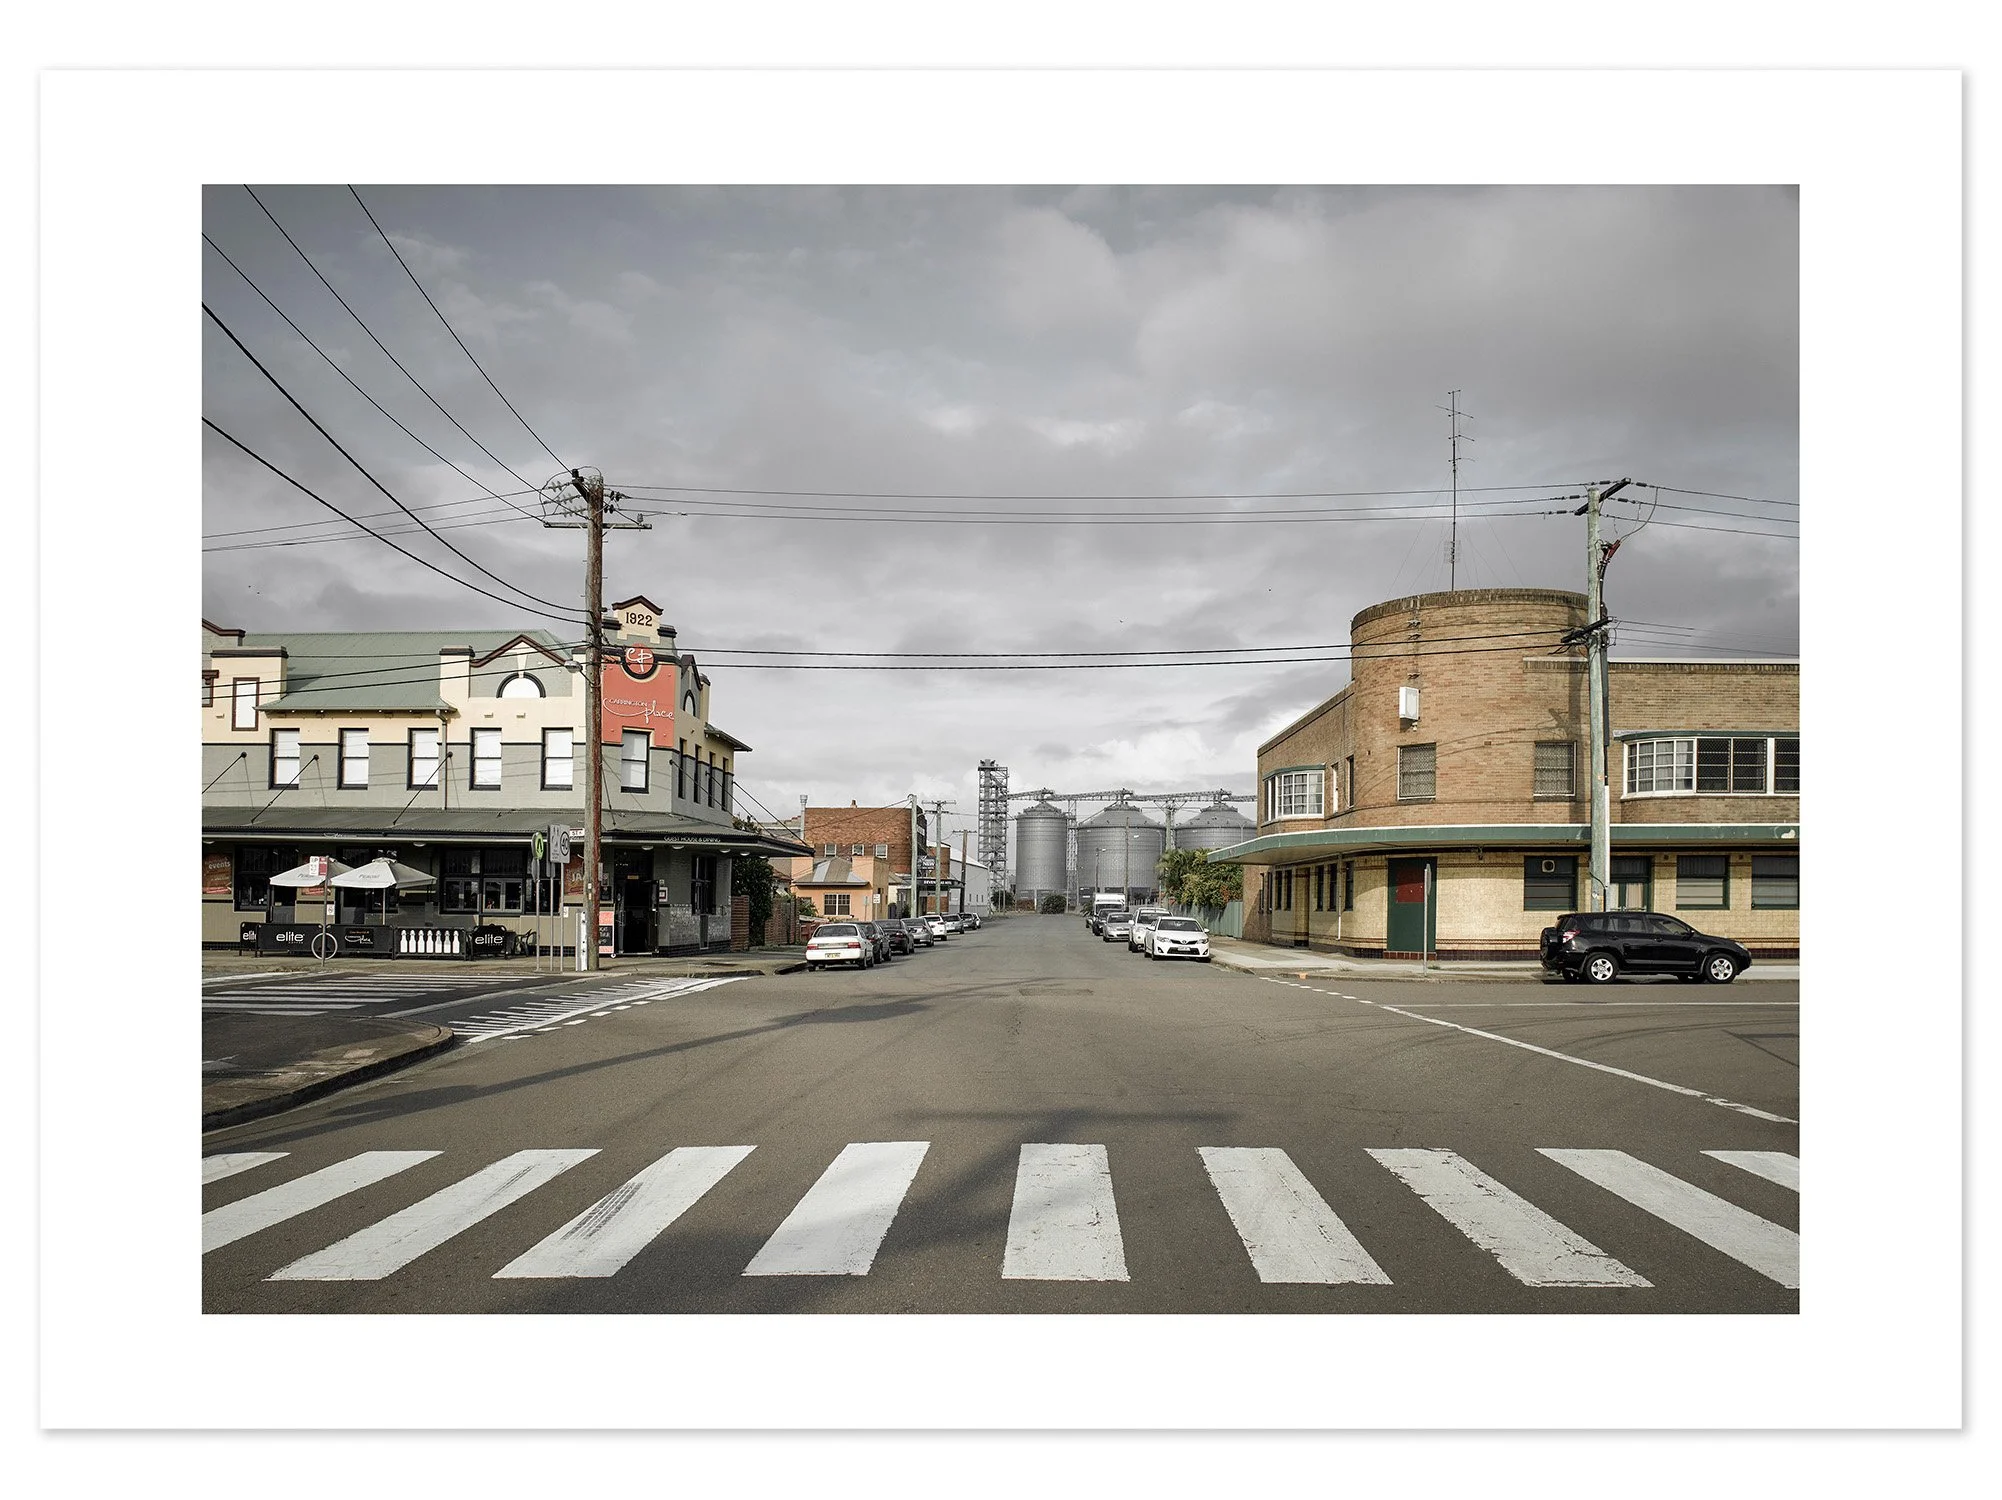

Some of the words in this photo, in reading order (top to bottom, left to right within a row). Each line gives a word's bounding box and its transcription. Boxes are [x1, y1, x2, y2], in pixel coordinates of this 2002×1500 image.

[625, 611, 653, 627] 1922
[644, 699, 675, 724] place
[561, 837, 569, 851] 40
[208, 861, 231, 870] events
[275, 931, 304, 942] elite
[474, 934, 503, 945] elite
